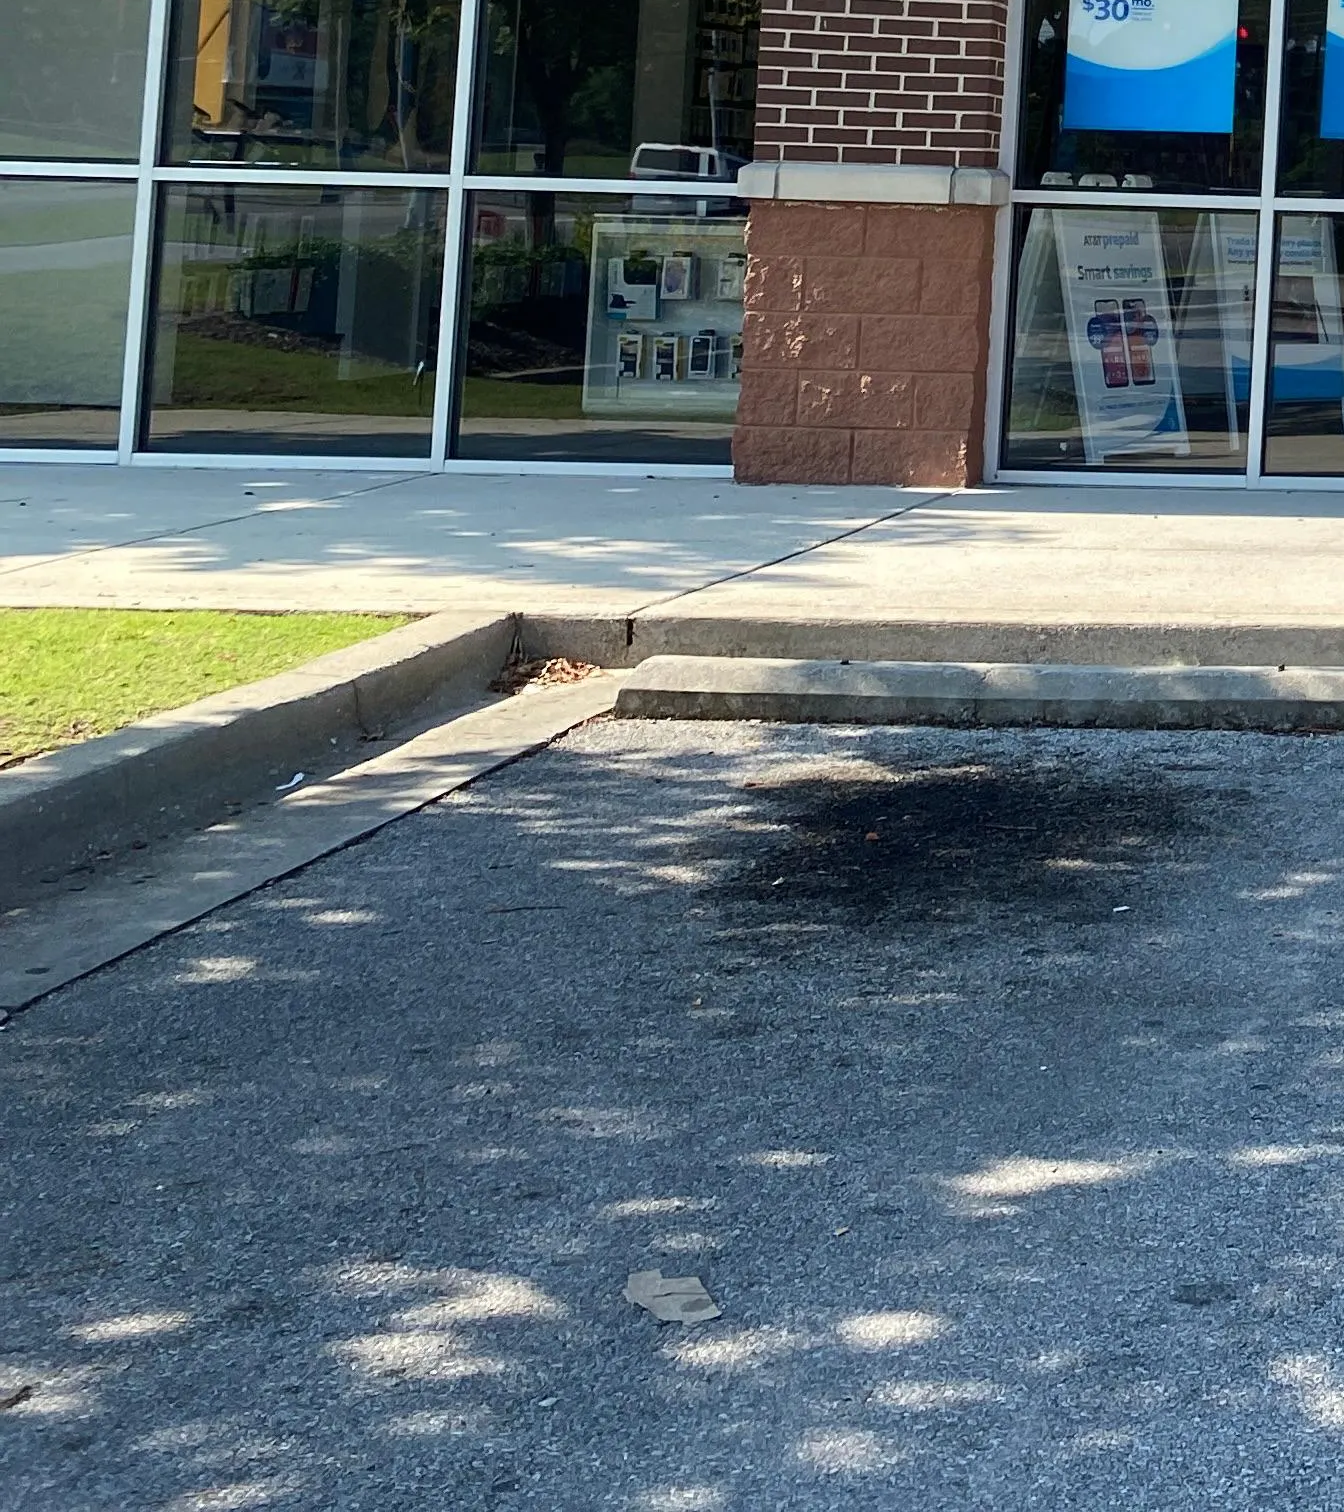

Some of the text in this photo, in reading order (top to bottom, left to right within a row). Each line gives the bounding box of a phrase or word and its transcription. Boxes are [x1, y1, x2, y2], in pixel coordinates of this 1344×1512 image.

[1102, 231, 1139, 249] prepaid
[1077, 264, 1152, 283] Smart savings
